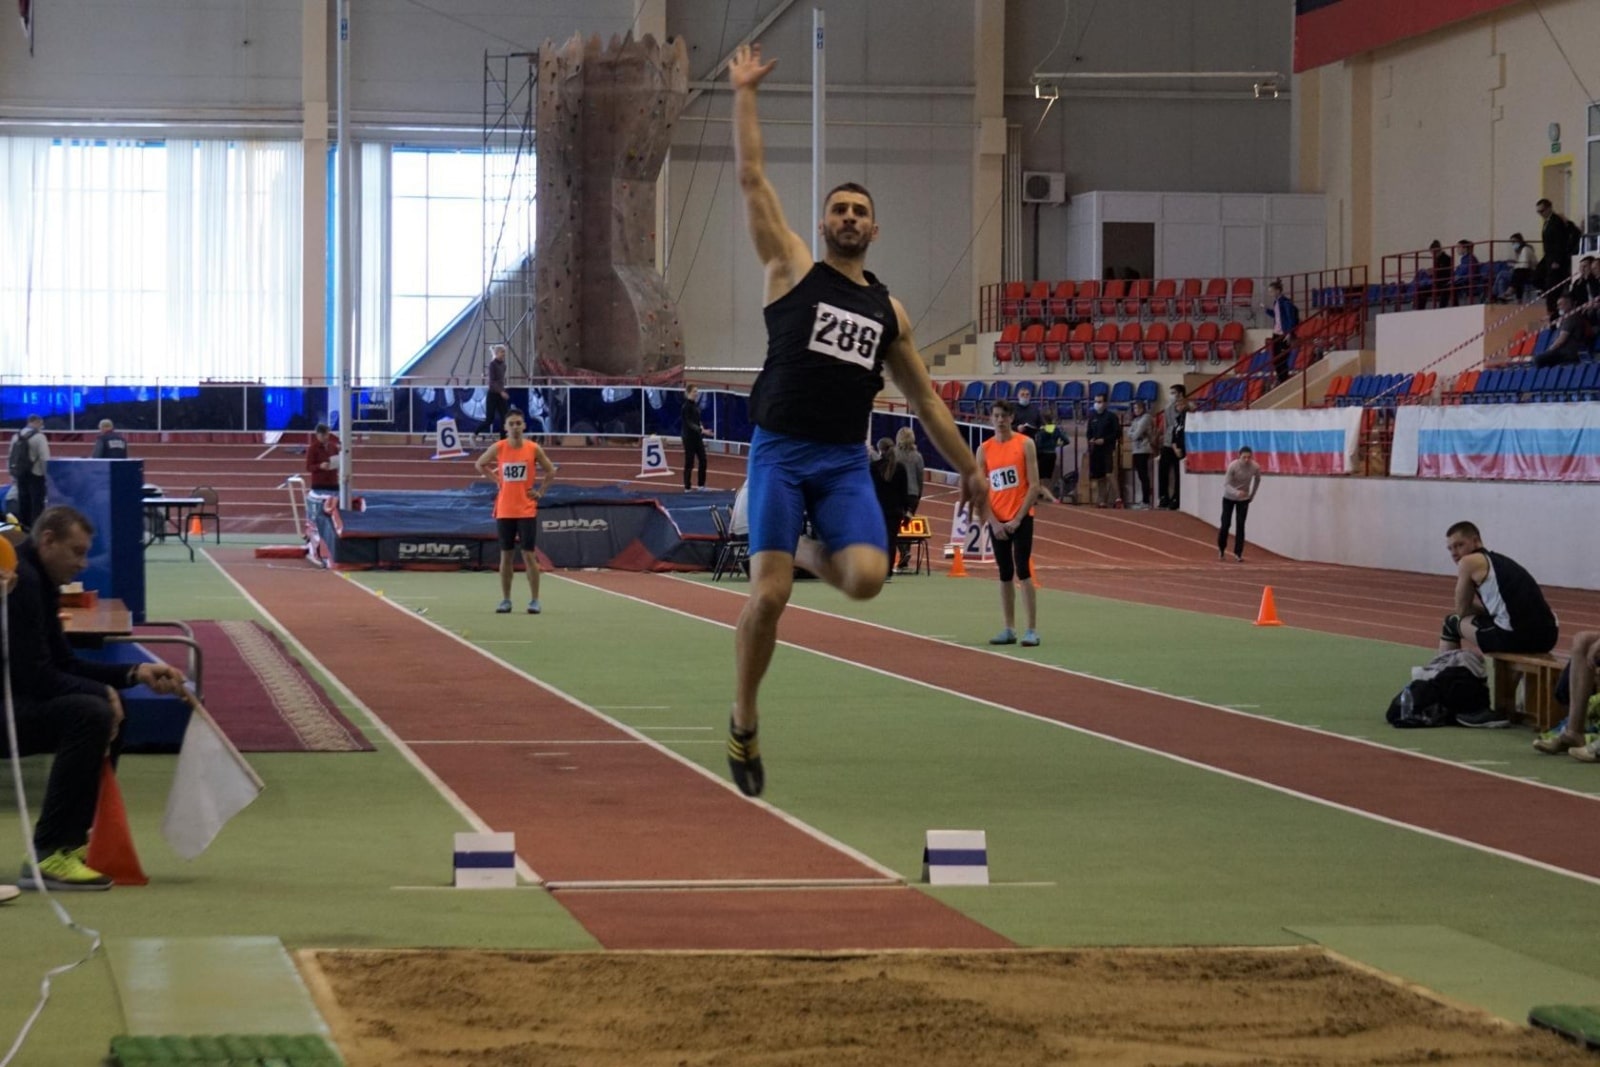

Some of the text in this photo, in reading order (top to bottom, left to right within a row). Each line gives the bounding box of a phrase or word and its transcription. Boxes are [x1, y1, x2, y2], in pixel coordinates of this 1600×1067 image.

[815, 311, 877, 359] 286
[441, 426, 456, 448] 6
[646, 444, 661, 467] 5
[503, 465, 526, 478] 487
[541, 518, 608, 531] DIMA
[399, 542, 468, 557] DIMA
[967, 524, 981, 553] 2
